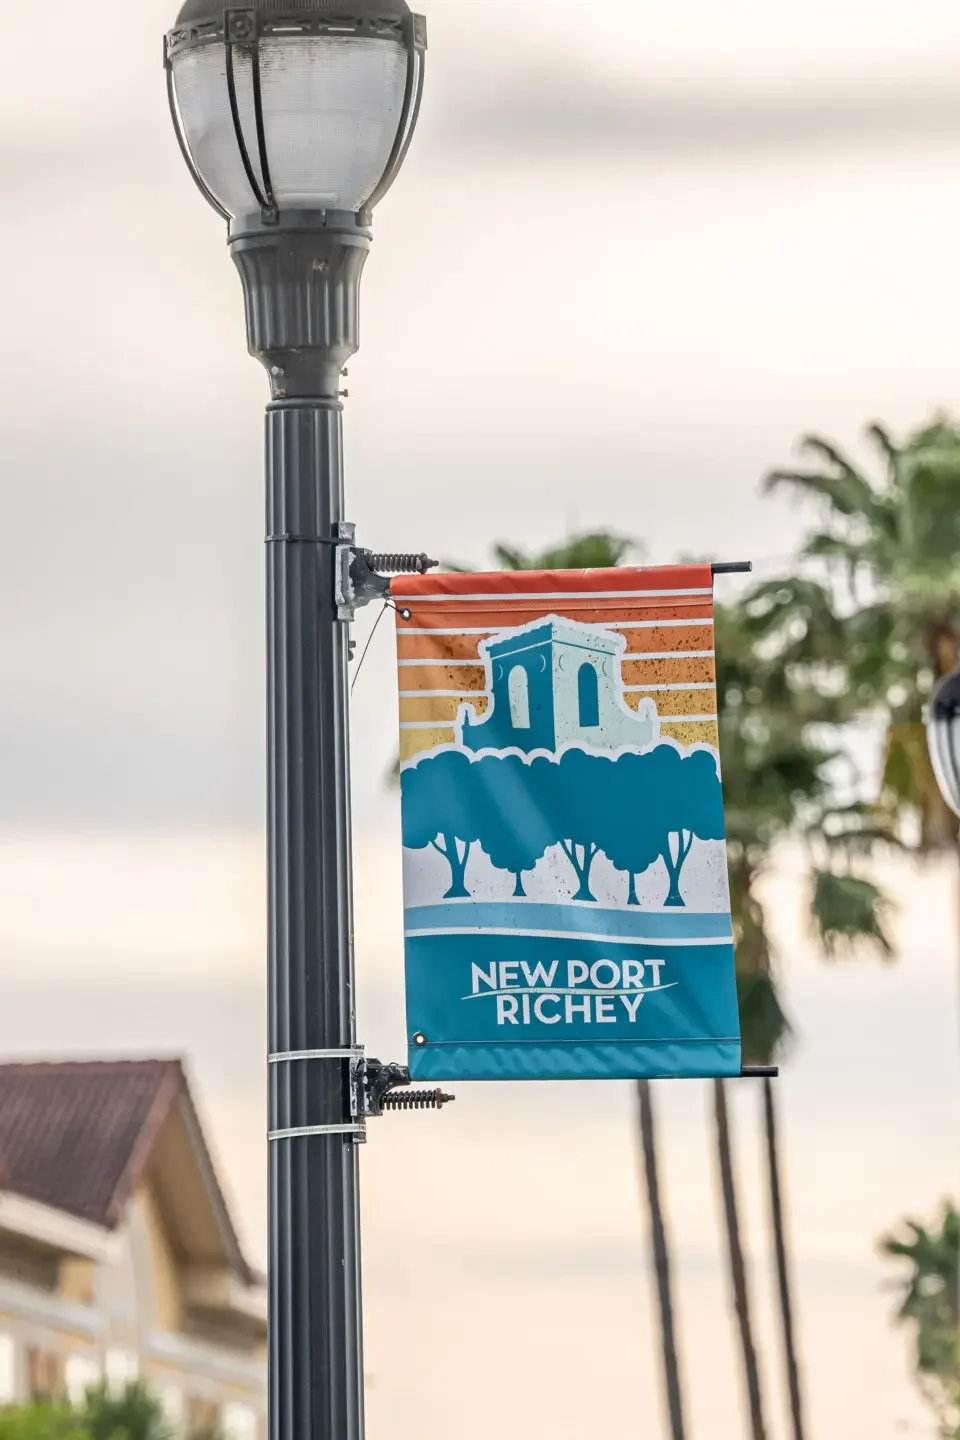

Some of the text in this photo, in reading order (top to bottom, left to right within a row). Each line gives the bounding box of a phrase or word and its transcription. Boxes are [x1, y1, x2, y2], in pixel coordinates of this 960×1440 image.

[471, 959, 666, 994] NEW PORT
[496, 993, 645, 1025] RICHEY
